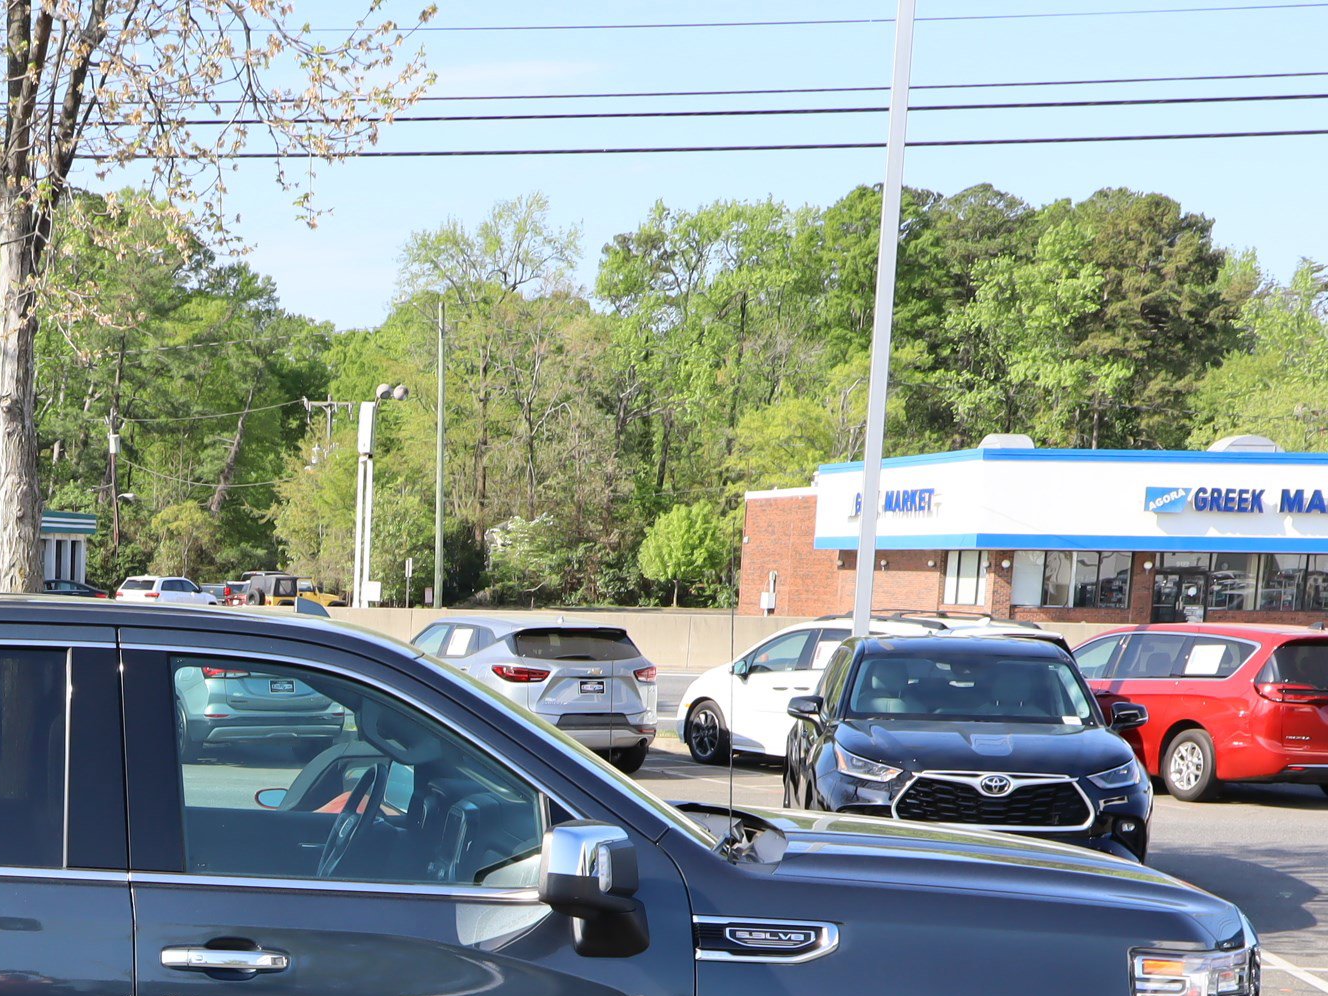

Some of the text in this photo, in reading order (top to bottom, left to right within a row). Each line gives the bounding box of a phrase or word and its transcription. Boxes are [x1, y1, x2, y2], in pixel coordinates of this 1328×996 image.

[884, 488, 935, 512] MARKET
[1148, 488, 1186, 511] AGORA
[1194, 487, 1265, 513] GREEK
